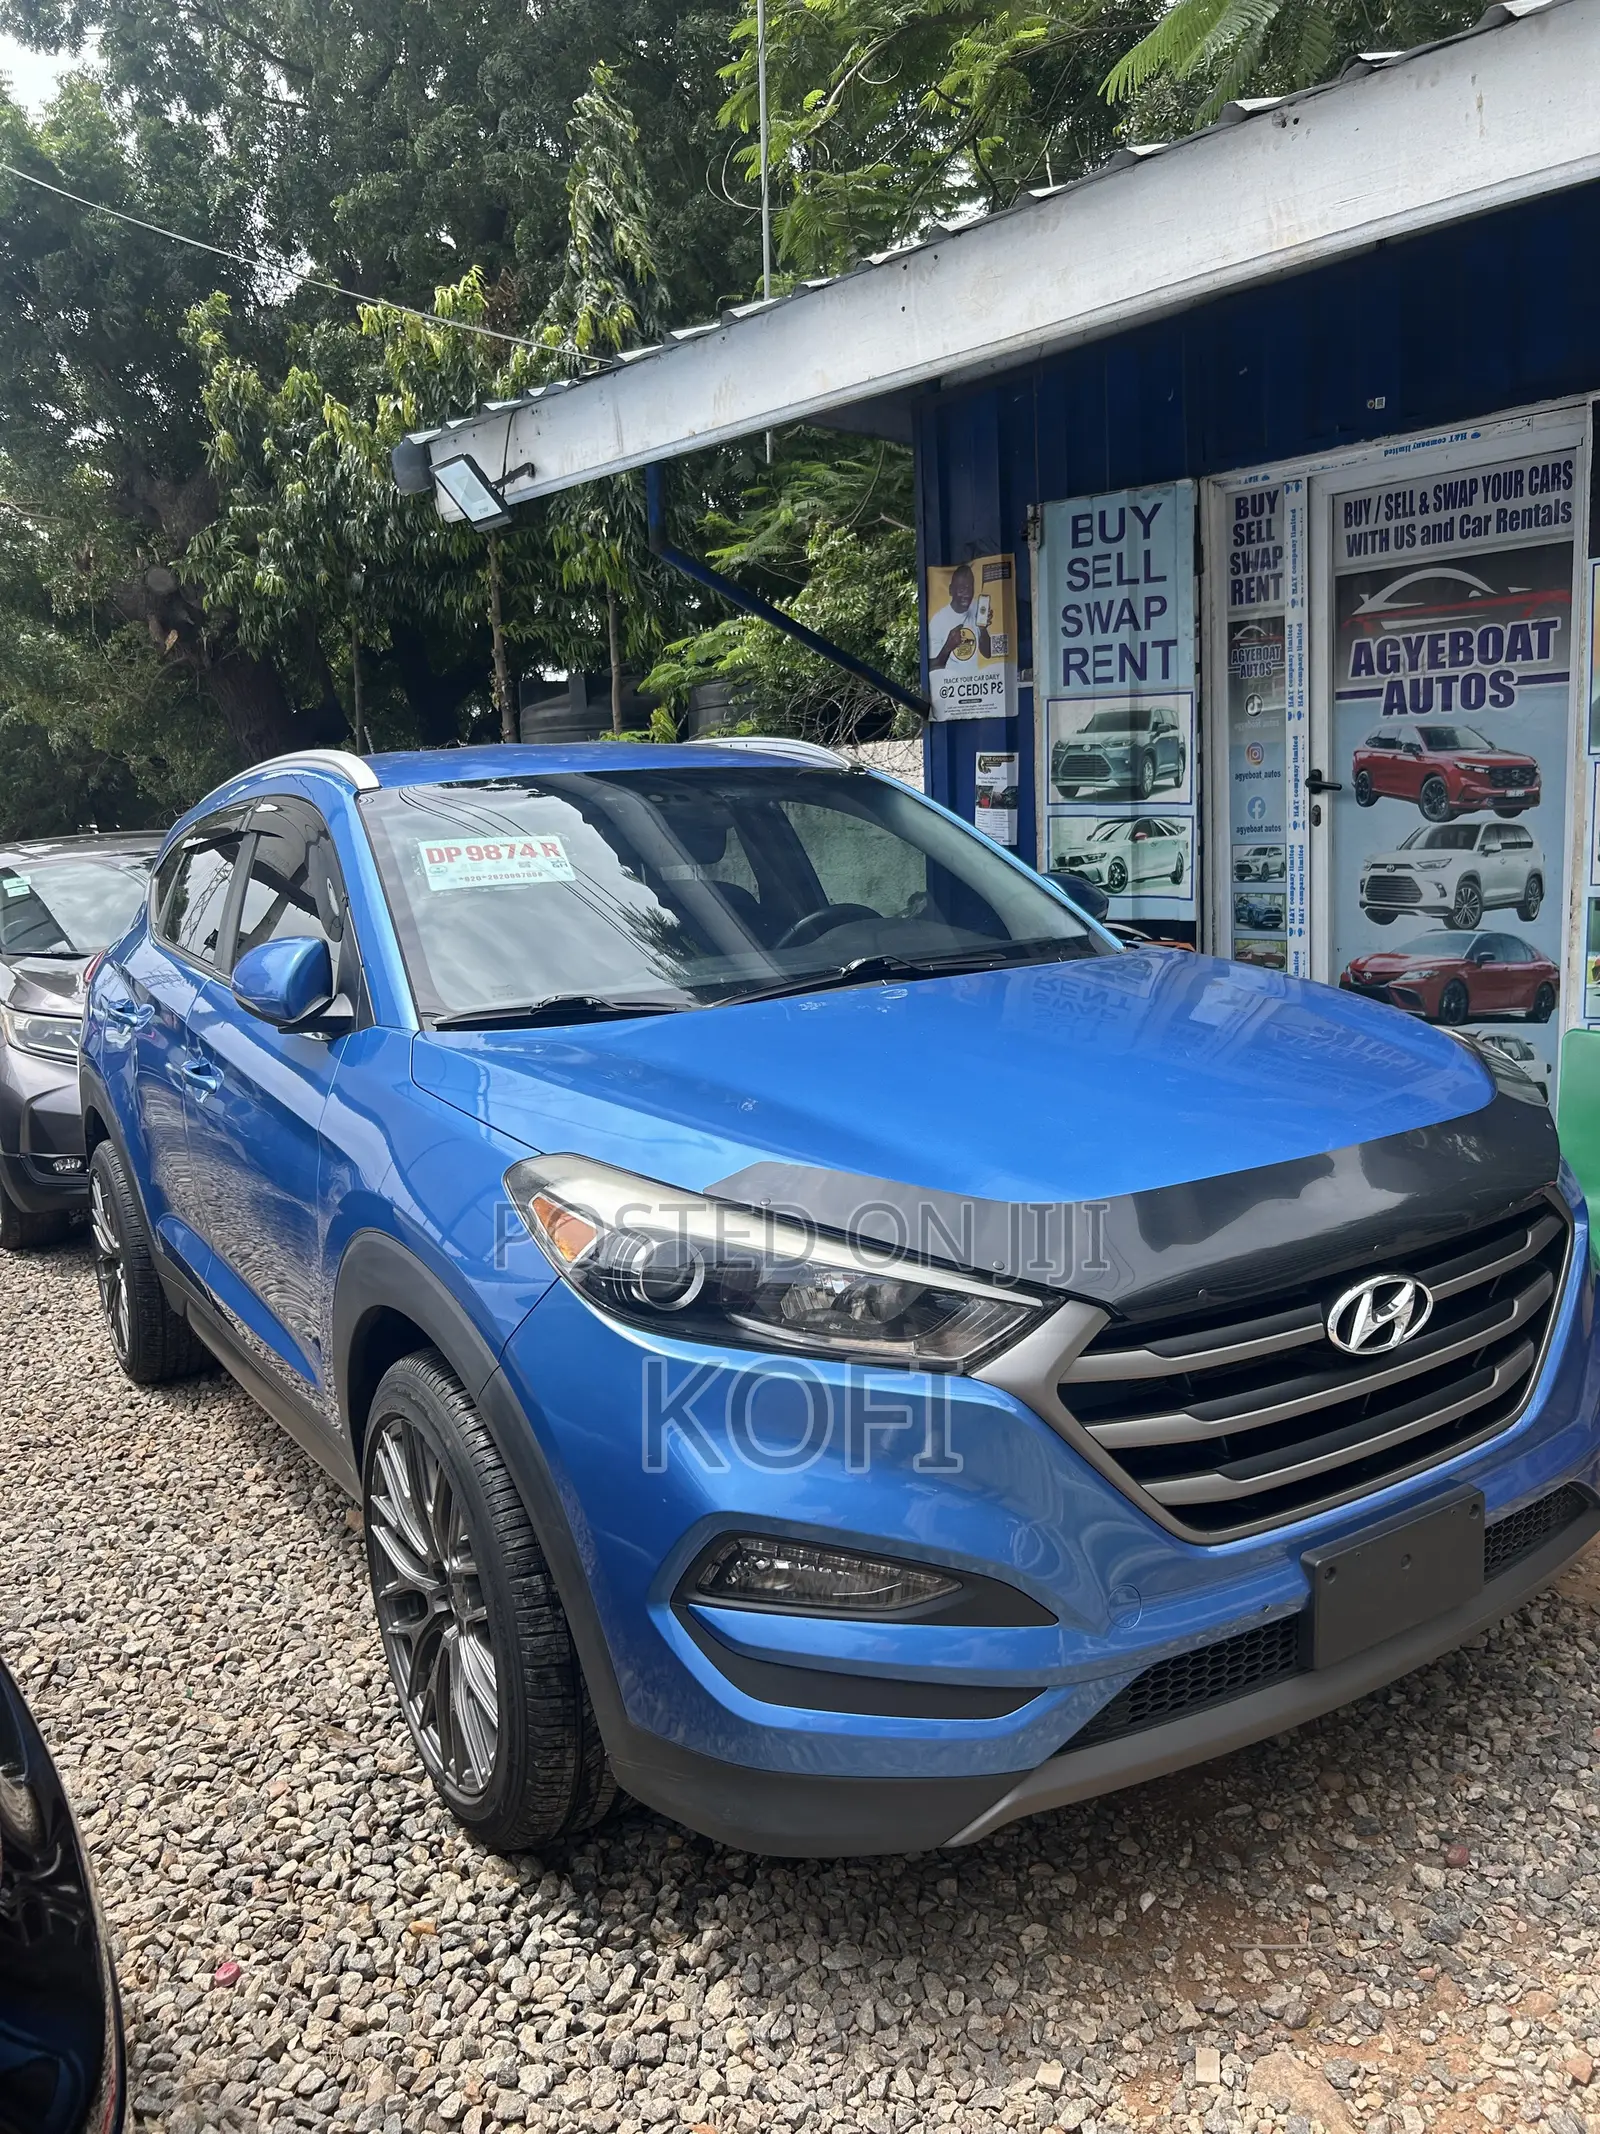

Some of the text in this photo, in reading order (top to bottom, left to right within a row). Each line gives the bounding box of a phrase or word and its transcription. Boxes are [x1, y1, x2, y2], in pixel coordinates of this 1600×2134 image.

[1383, 432, 1467, 457] H&T company limited
[1235, 490, 1279, 520] BUY
[1343, 496, 1372, 529] BUY
[1384, 490, 1416, 522] SELL
[1418, 491, 1430, 518] &
[1433, 478, 1478, 512] SWAP
[1482, 469, 1524, 504] YOUR
[1528, 460, 1574, 497] CARS
[1071, 502, 1163, 549] BUY
[1232, 518, 1276, 547] SELL
[1346, 499, 1573, 558] WITH US and Car Rentals
[1066, 549, 1167, 592] SELL
[1229, 545, 1283, 576] SWAP
[1230, 572, 1283, 606] RENT
[1061, 595, 1168, 638] SWAP
[1062, 639, 1178, 687] RENT
[1231, 645, 1281, 664] AGYEBOAT
[1349, 618, 1560, 679] AGYEBOAT
[1240, 662, 1273, 679] AUTOS
[940, 686, 954, 699] @2
[957, 683, 988, 697] CEDIS
[1381, 669, 1516, 717] AUTOS
[1236, 824, 1282, 836] agyeboat autos
[426, 842, 561, 865] DP 9874 R
